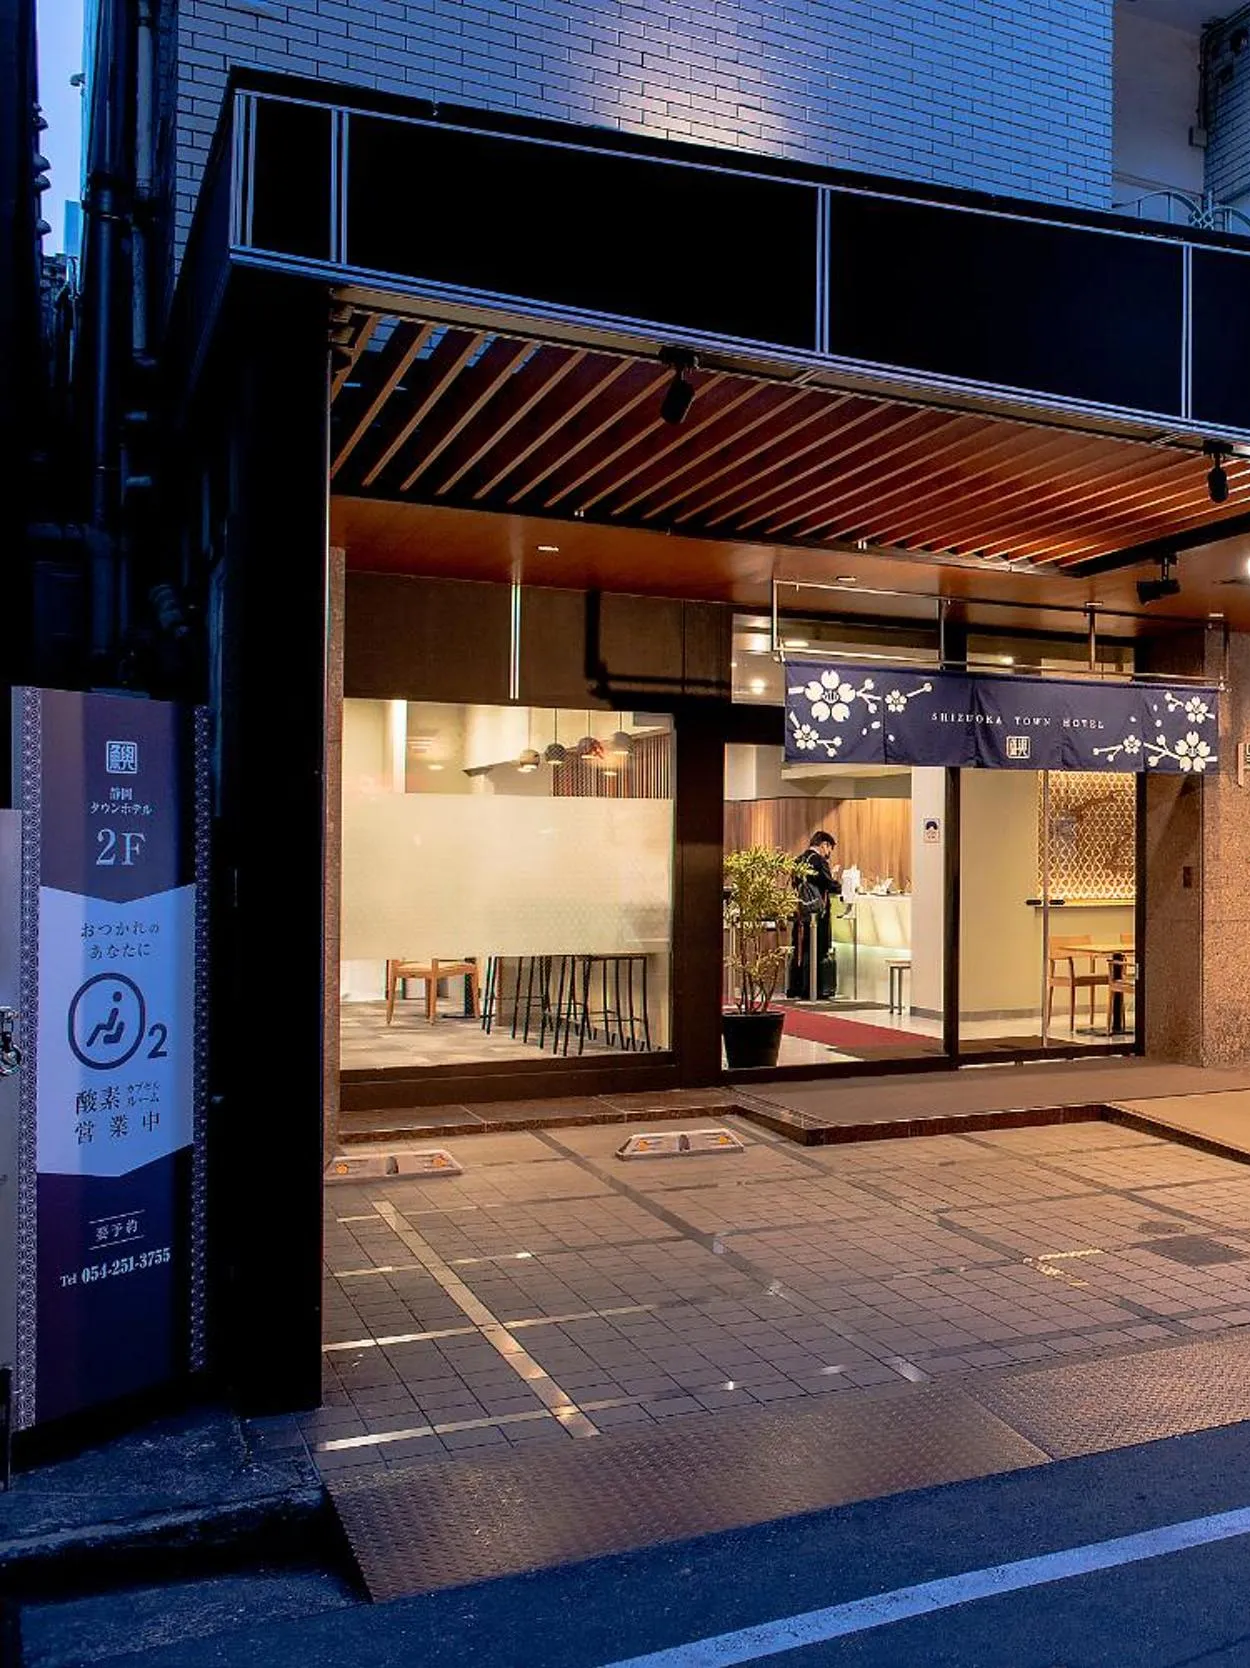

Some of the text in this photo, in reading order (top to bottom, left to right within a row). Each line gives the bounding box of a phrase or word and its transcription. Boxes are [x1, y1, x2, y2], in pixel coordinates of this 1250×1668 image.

[931, 711, 1105, 730] SHIZUOKA TOWN HOTEL
[90, 801, 153, 816] タウンホテル
[96, 828, 146, 867] 2F
[81, 920, 160, 938] おつかれの
[90, 942, 152, 960] あなたに
[76, 1086, 121, 1116] 酸素
[74, 1111, 160, 1146] 営業中
[81, 1247, 171, 1285] 054-251-3755
